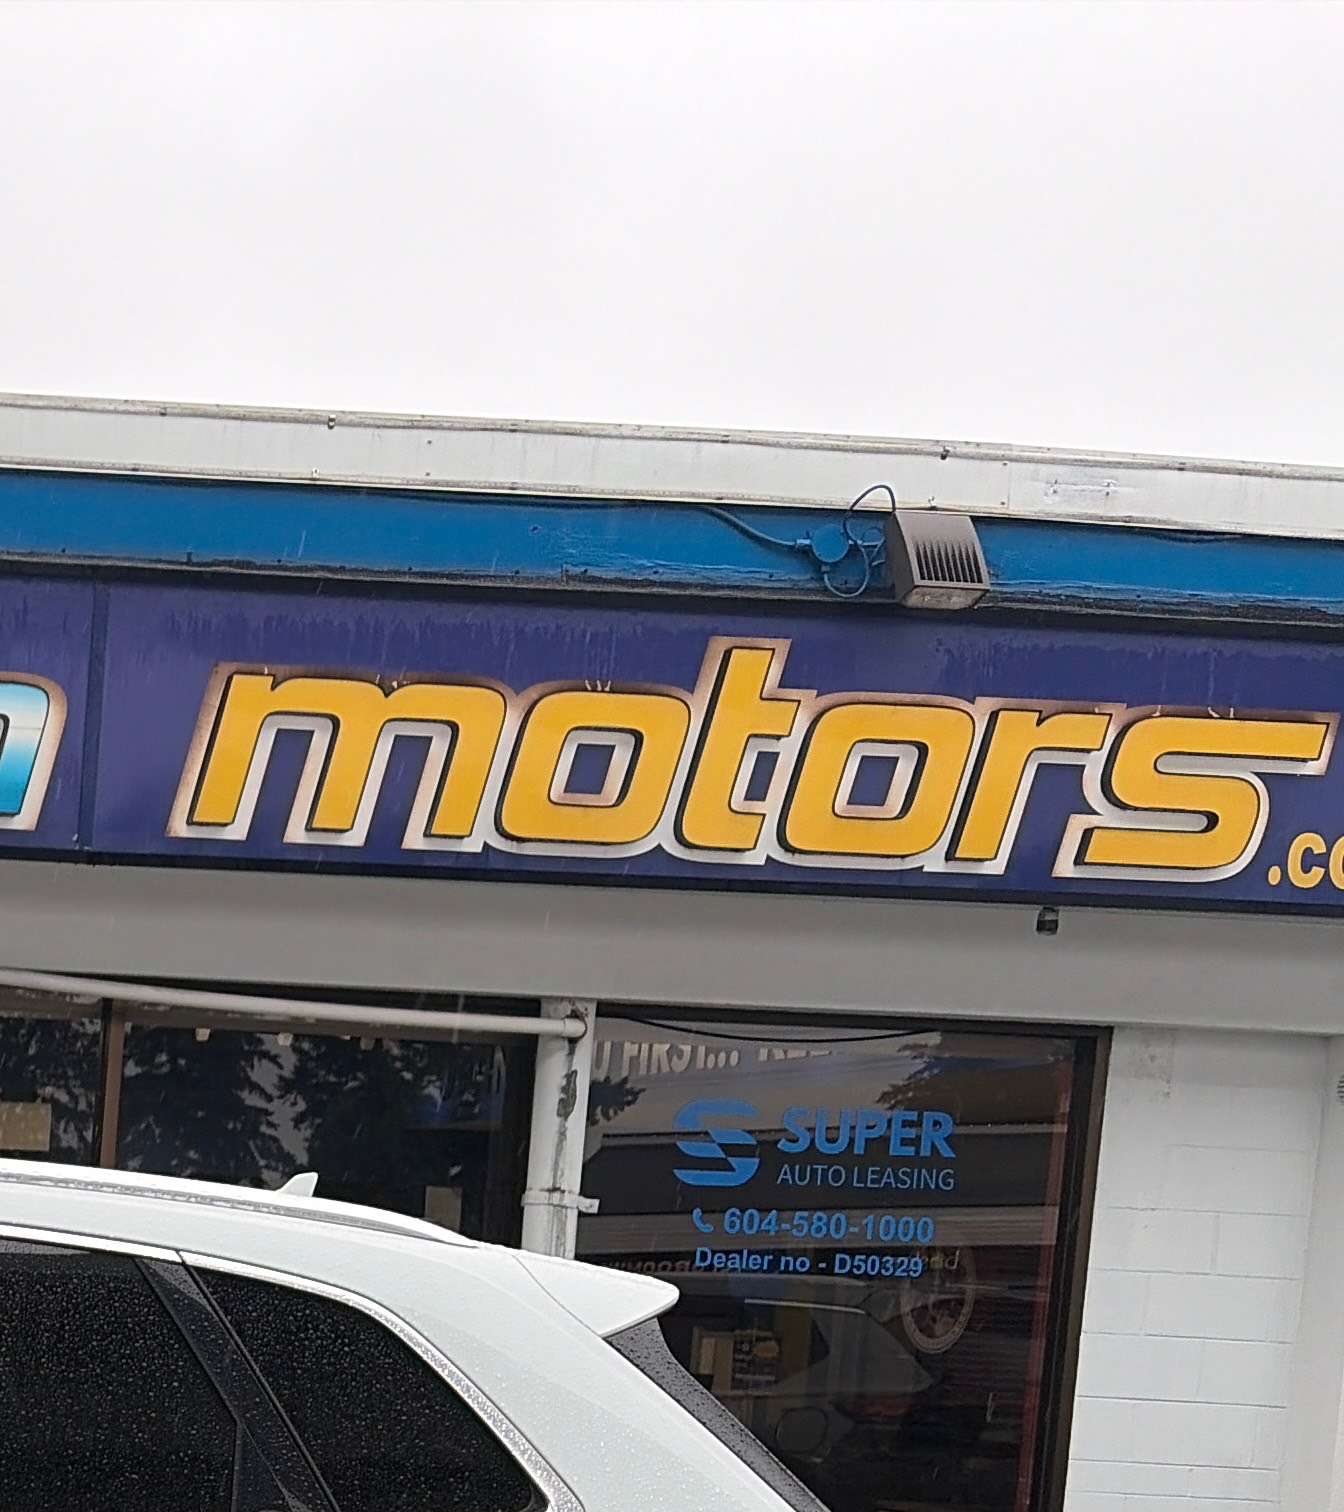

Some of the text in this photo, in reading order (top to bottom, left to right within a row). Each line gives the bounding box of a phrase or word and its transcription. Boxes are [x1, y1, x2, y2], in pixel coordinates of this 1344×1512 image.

[168, 639, 1338, 880] motors
[777, 1105, 957, 1159] SUPER
[776, 1163, 956, 1191] AUTO LEASING
[723, 1207, 936, 1244] 604-580-1000
[694, 1247, 773, 1271] Dealer
[779, 1254, 810, 1273] no
[833, 1253, 925, 1278] D50329
